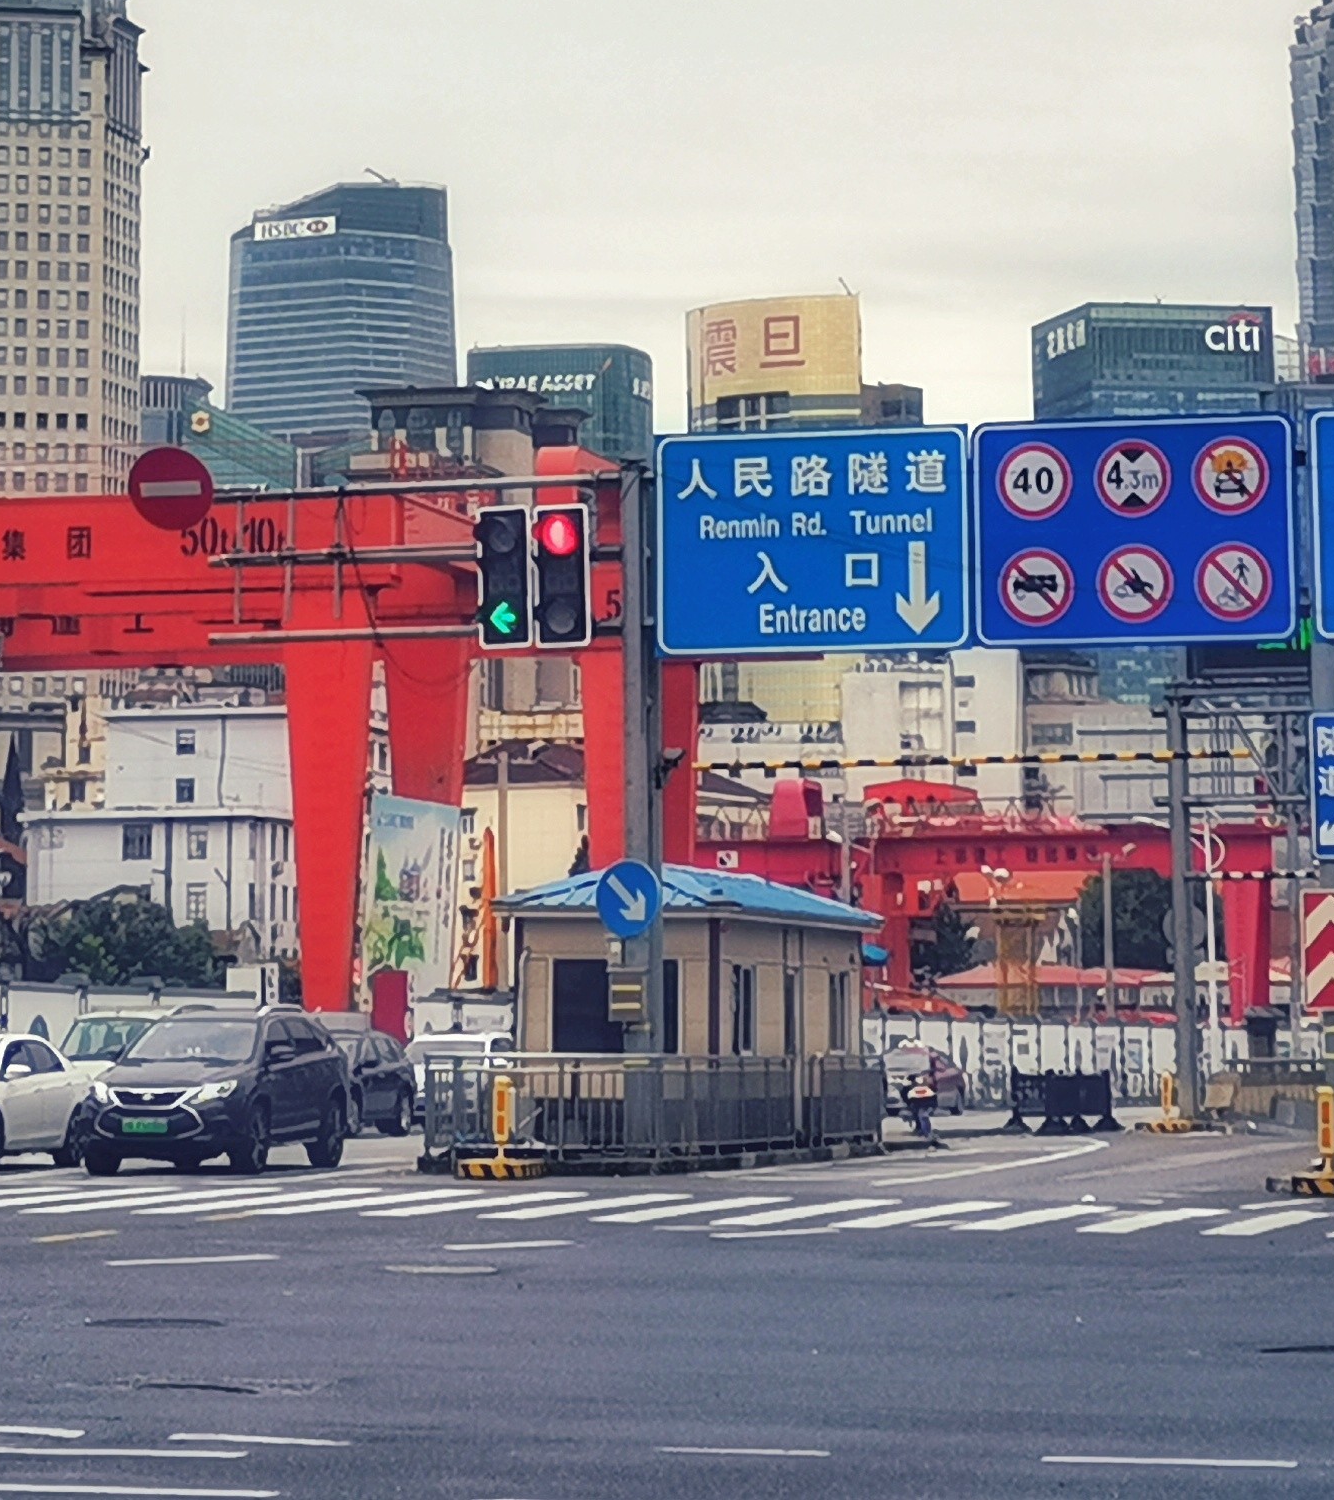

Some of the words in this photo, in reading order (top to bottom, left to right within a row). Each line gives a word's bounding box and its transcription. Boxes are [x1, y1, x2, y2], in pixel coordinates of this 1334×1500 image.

[704, 315, 806, 377] 震旦
[677, 450, 947, 501] 人民路隧道
[1012, 468, 1054, 494] 40
[699, 513, 780, 540] Renmin
[791, 511, 827, 537] Rd.
[849, 507, 933, 535] Tunnel
[747, 551, 880, 595] 入口
[759, 603, 866, 634] Entrance
